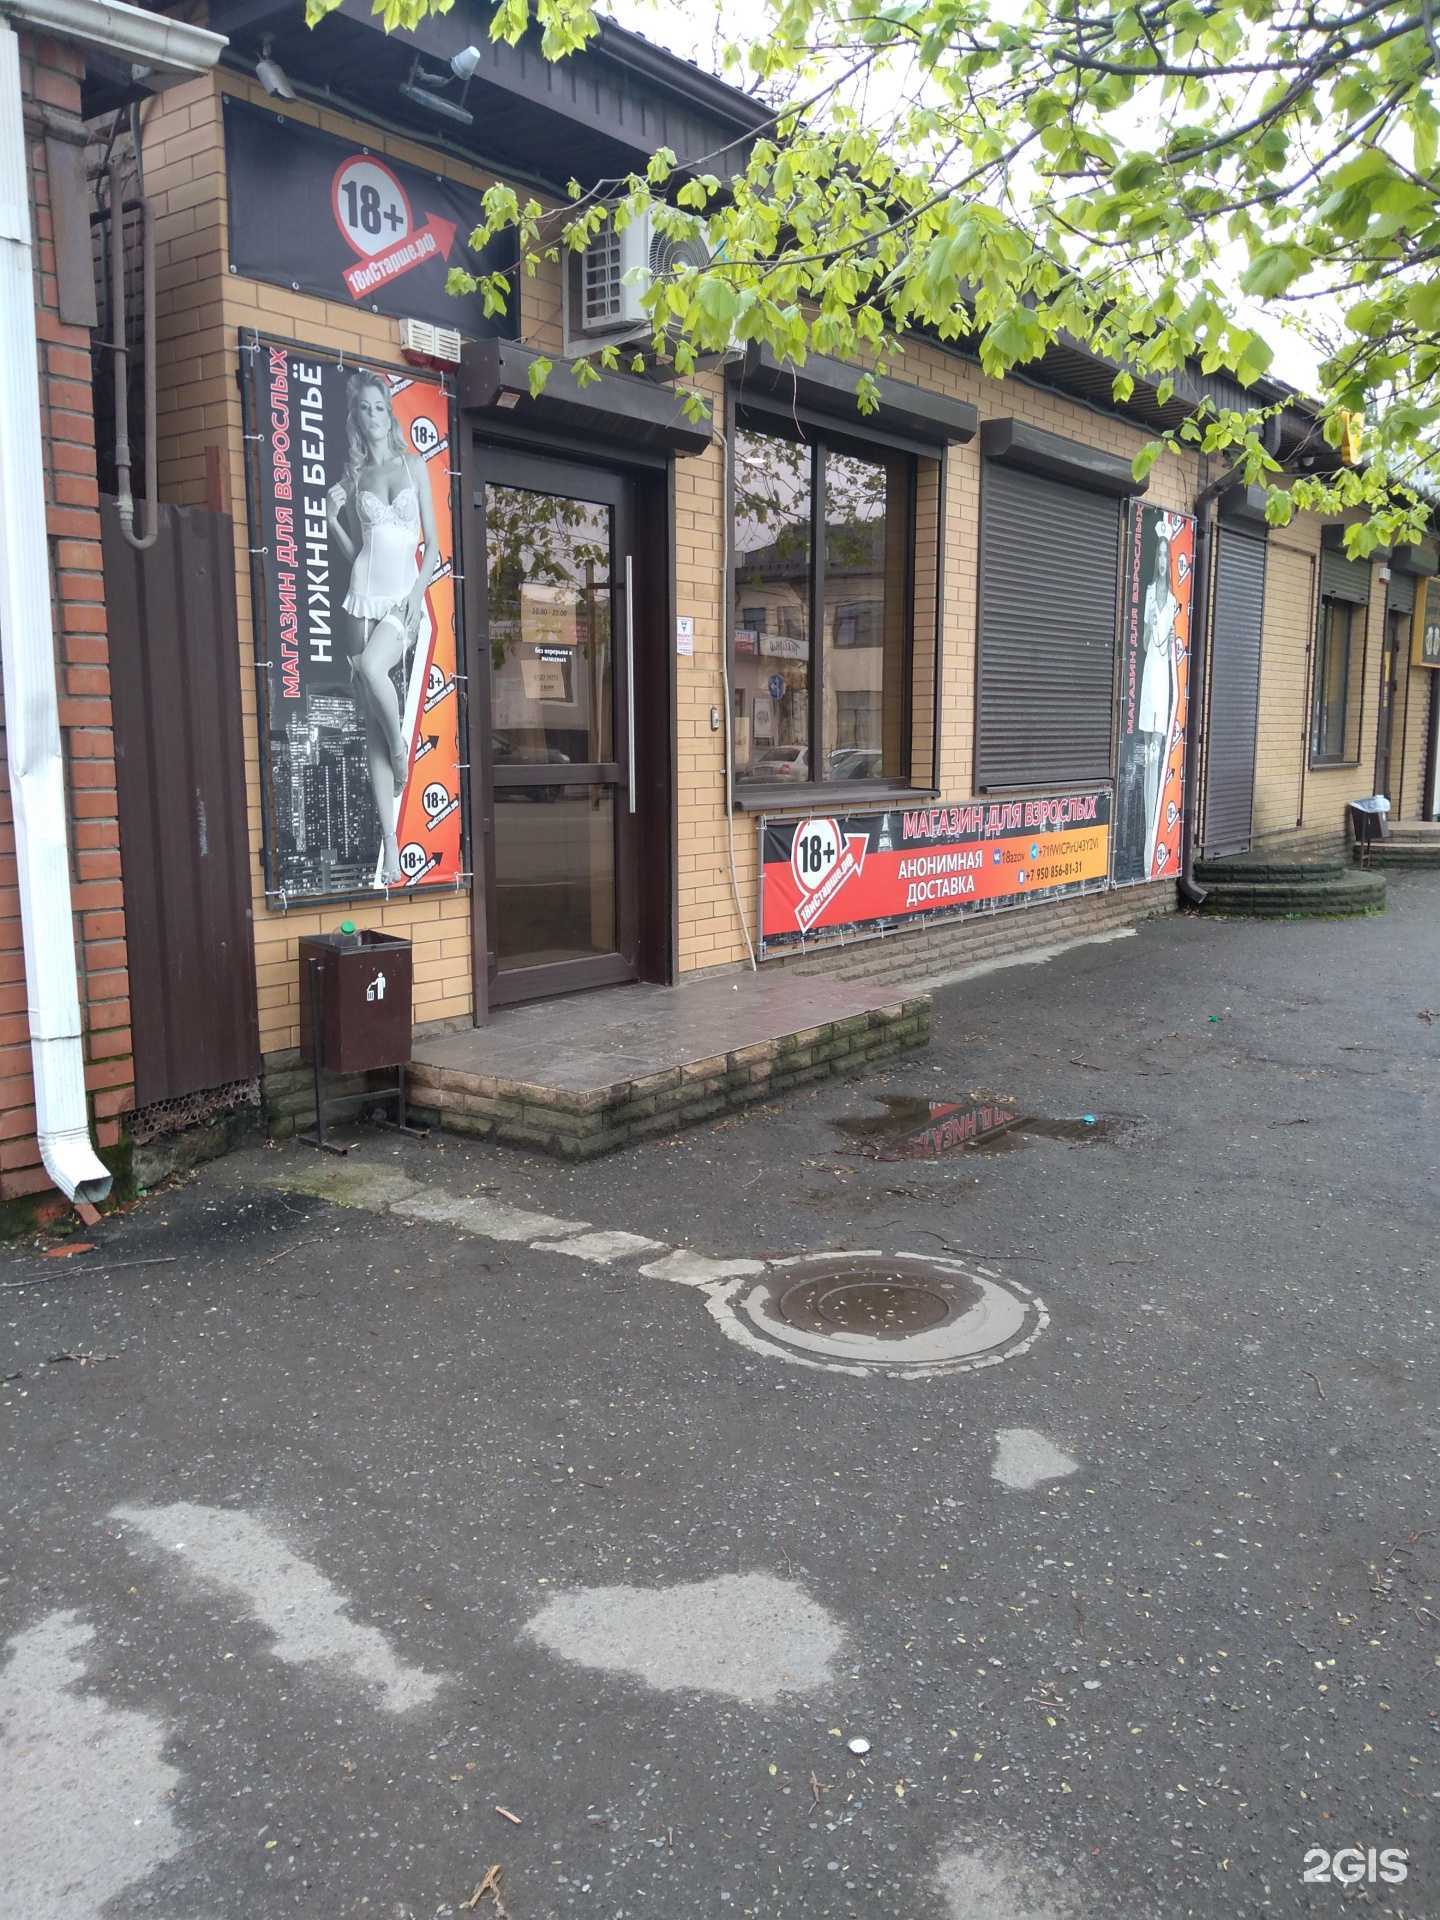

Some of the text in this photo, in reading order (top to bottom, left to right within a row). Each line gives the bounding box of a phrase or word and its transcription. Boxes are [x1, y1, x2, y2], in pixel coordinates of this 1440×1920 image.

[341, 180, 403, 235] 18+
[348, 232, 437, 292] 18иСтарше.рф
[413, 425, 436, 444] 18+
[269, 347, 301, 699] МАГАЗИН ДЛЯ ВЗРОСЛЫХ
[293, 362, 333, 663] НИЖНЕЕ БЕЛЬЁ
[1126, 503, 1144, 734] МАГАЗИН ДЛЯ ВЗРОСЛЫХ
[428, 673, 443, 690] 8+
[425, 792, 447, 809] 18+
[902, 795, 1099, 840] МАГАЗИН ДЛЯ ВЗРОСЛЫХ
[402, 852, 424, 869] 18+
[799, 835, 835, 873] 18+
[898, 850, 983, 880] АНОНИМНАЯ
[1026, 861, 1082, 882] +7 950 856-81-31
[906, 875, 975, 907] ДОСТАВКА
